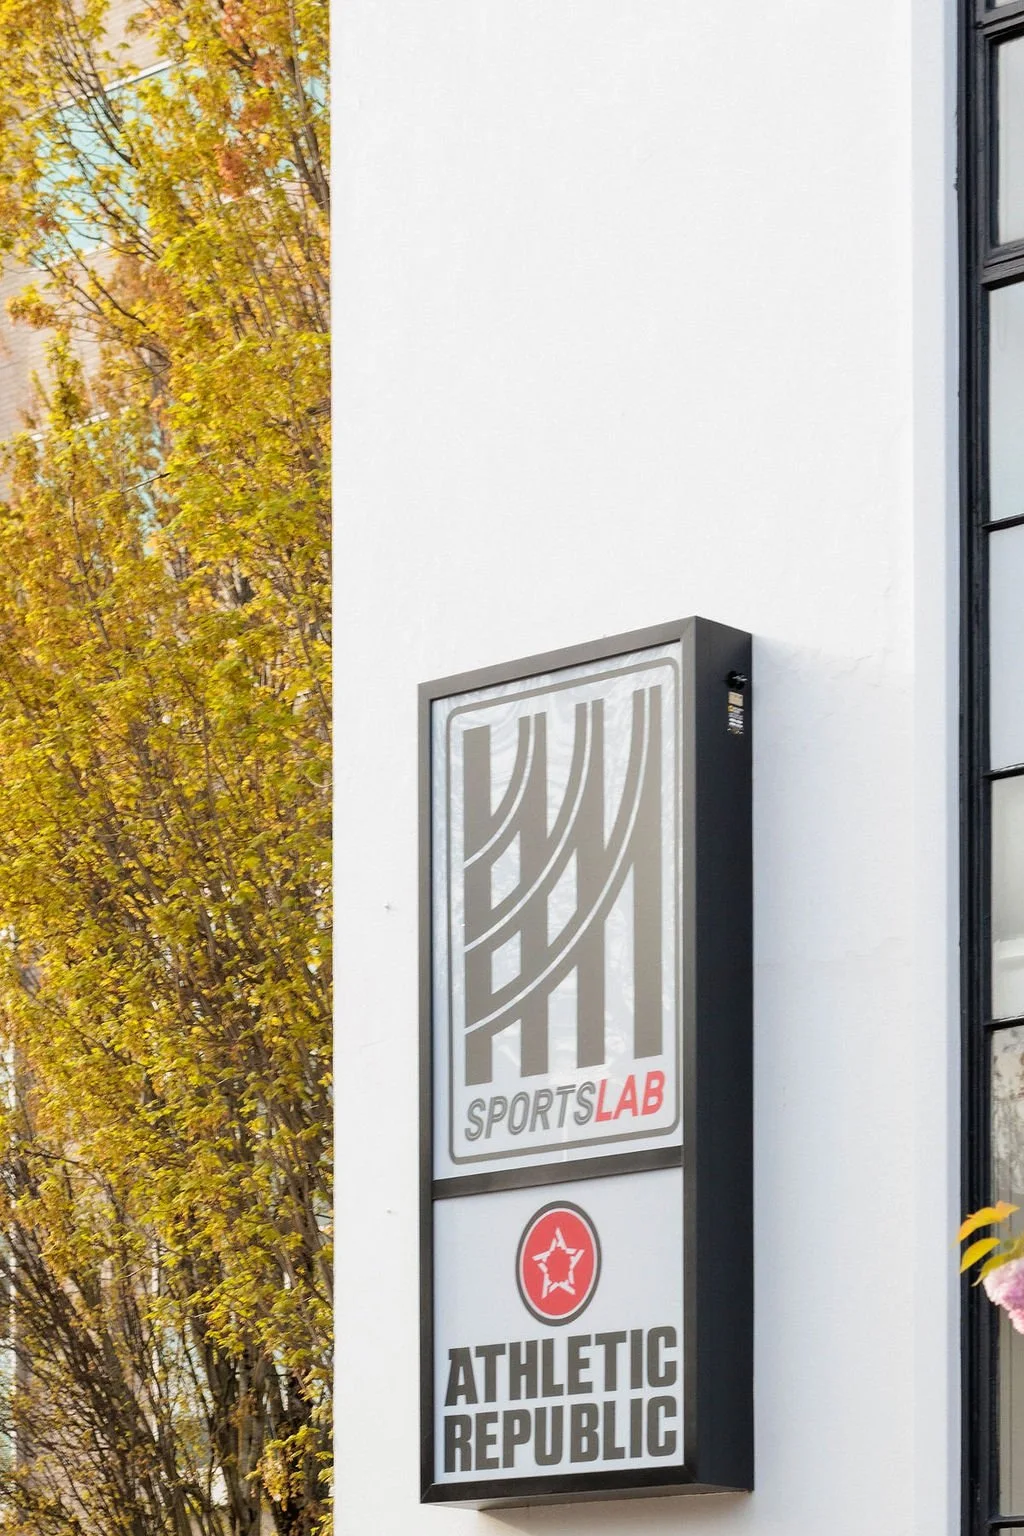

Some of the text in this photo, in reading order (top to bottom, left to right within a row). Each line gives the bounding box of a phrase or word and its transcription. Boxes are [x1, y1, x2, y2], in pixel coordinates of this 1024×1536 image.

[464, 1070, 666, 1142] SPORTSLAB
[444, 1326, 678, 1407] ATHLETIC
[444, 1395, 678, 1473] REPUBLIC
